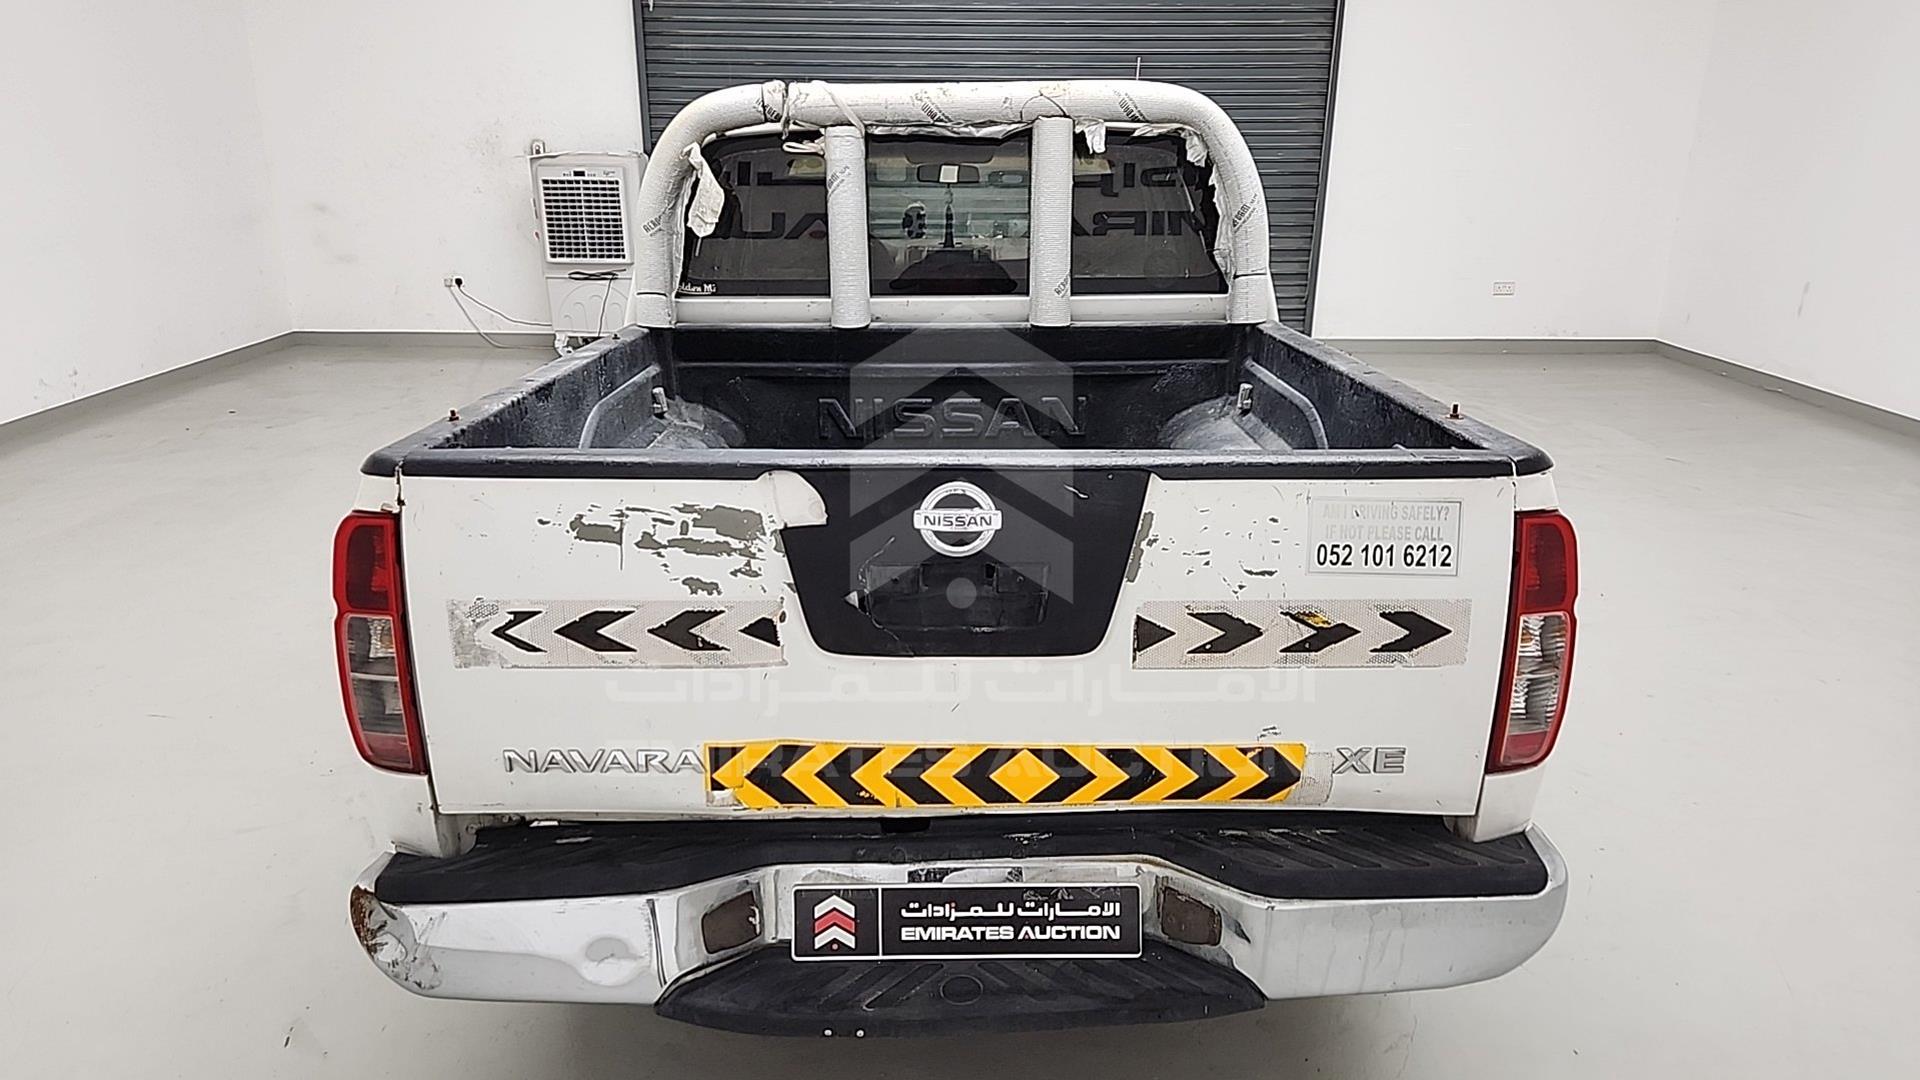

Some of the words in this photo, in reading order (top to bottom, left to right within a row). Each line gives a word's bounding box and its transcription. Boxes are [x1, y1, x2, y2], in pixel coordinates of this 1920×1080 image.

[818, 397, 1087, 440] NISSAN
[923, 514, 993, 528] NISSAN
[1351, 505, 1398, 520] DRIVING
[1401, 505, 1450, 521] SAFELY?
[1340, 525, 1364, 540] NOT
[1367, 525, 1411, 541] PLEASE
[1414, 526, 1443, 541] CALL
[1316, 543, 1352, 566] 052
[1360, 544, 1394, 567] 101
[1403, 544, 1452, 567] 6212
[502, 748, 708, 774] NAVARA
[1333, 746, 1407, 775] XE
[900, 925, 1014, 941] EMIRATES
[1017, 925, 1121, 940] AUCTION
